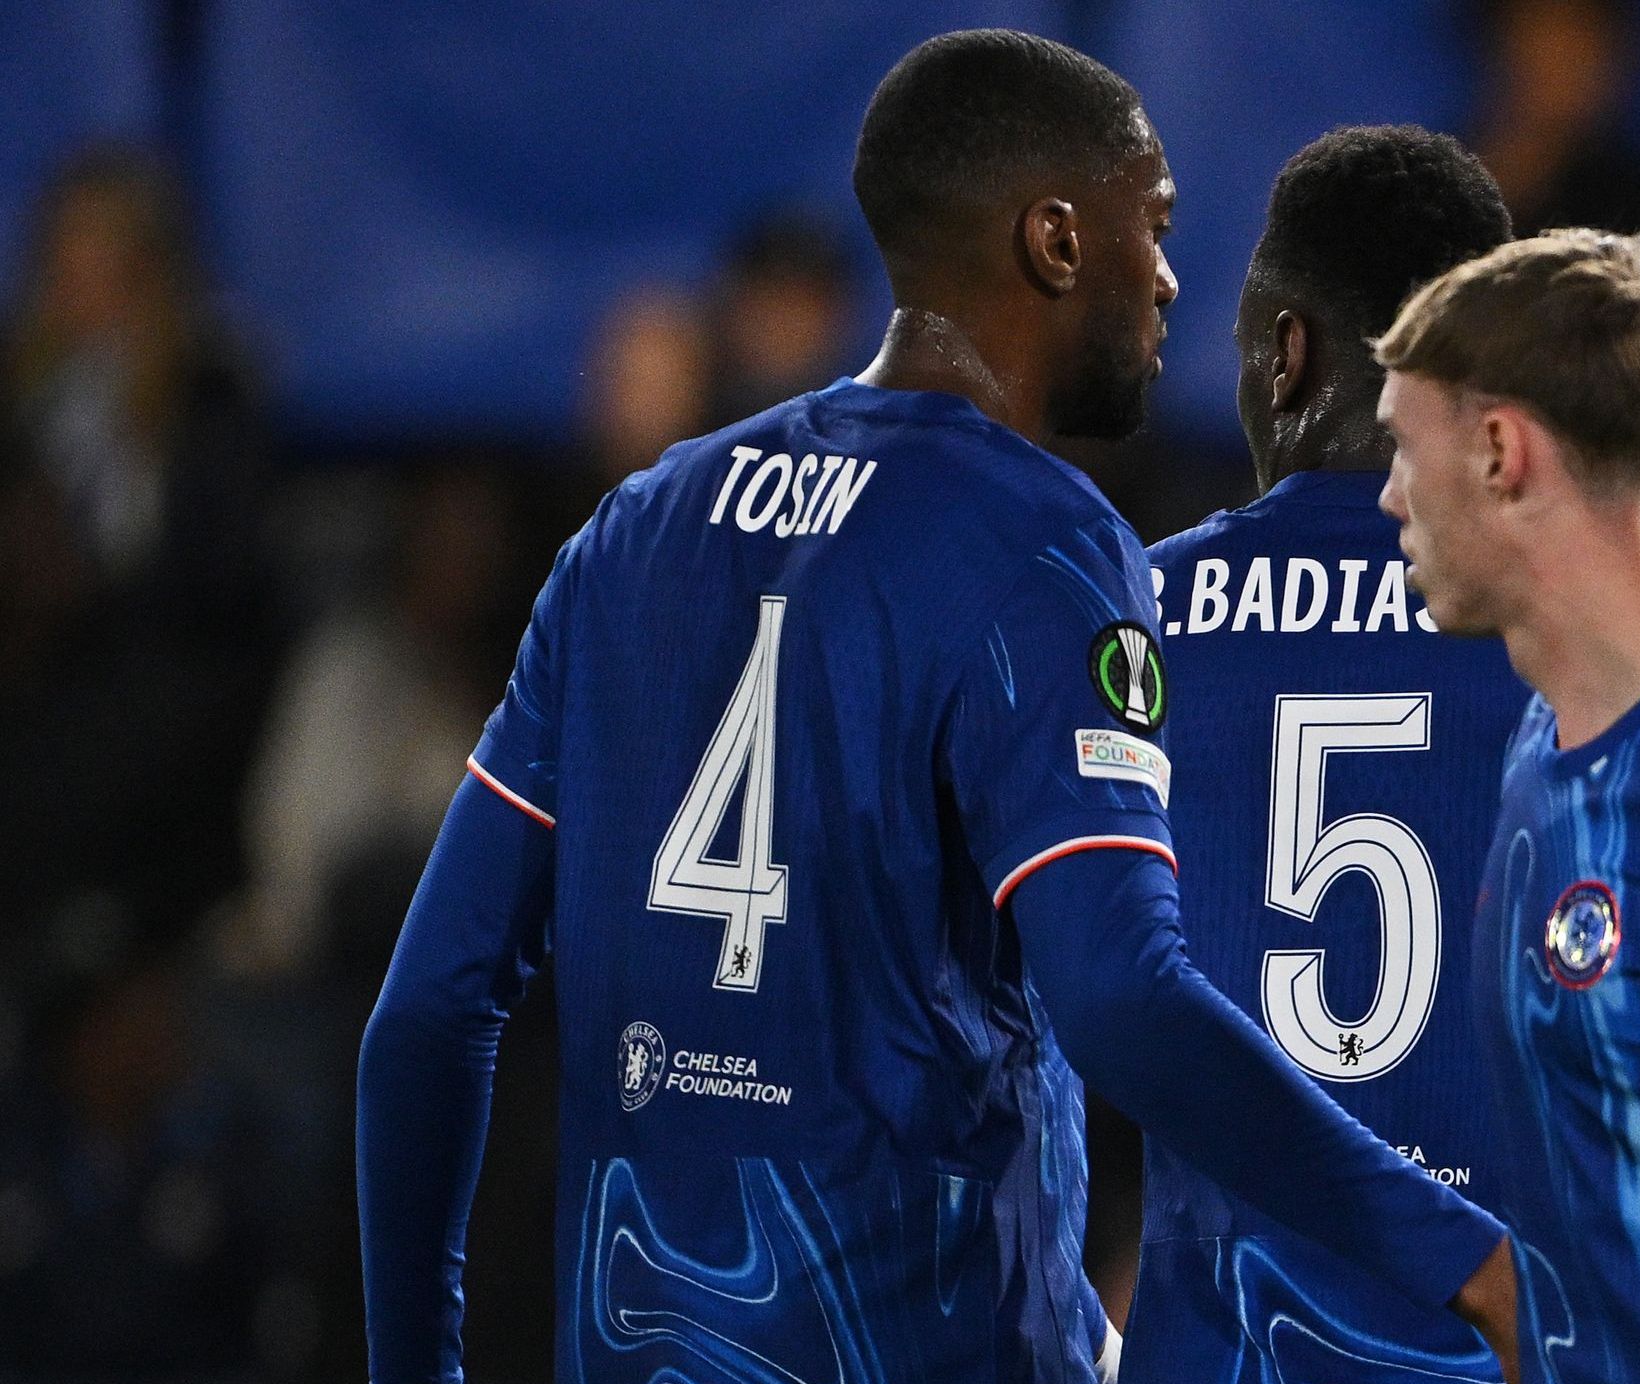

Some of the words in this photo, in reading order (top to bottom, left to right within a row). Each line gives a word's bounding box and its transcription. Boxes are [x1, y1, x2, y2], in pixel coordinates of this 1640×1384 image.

[710, 445, 878, 538] TOSIN
[1149, 556, 1440, 636] .BADIA
[647, 596, 788, 992] 4
[1260, 692, 1442, 1083] 5
[665, 1072, 792, 1105] FOUNDATION
[673, 1050, 758, 1077] CHELSEA
